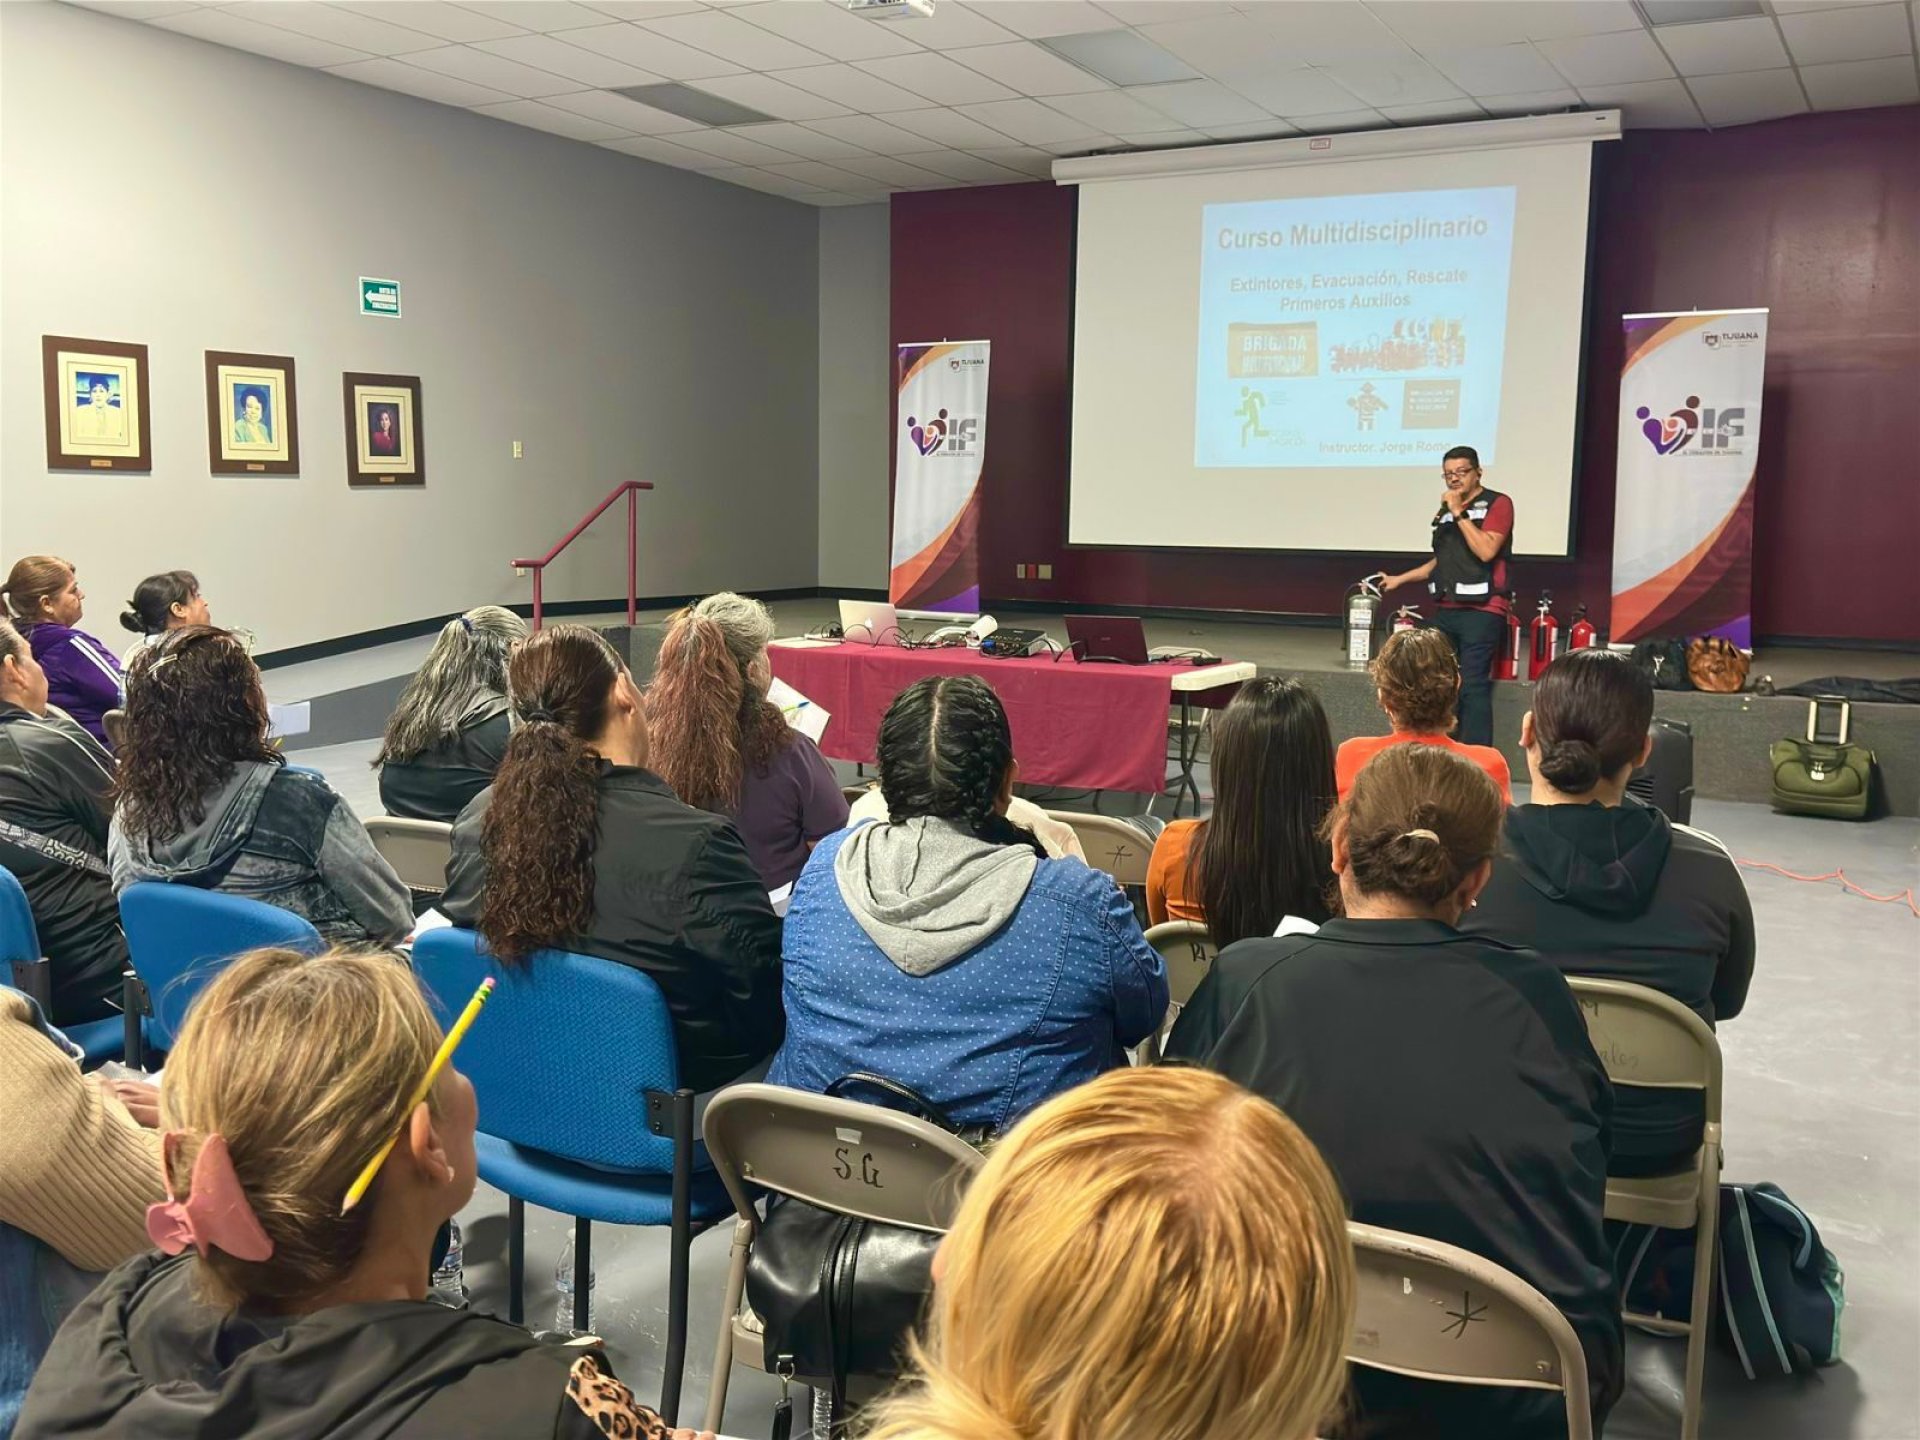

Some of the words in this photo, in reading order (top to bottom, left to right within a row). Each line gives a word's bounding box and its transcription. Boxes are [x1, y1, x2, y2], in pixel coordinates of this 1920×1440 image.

[1218, 228, 1283, 250] Curso
[1291, 216, 1488, 247] Multidisciplinario
[1230, 277, 1306, 293] Extintores,
[1311, 271, 1401, 290] Evacuación,
[1406, 269, 1468, 284] Rescate
[1280, 296, 1346, 312] Primeros
[1351, 292, 1411, 308] Auxilios
[1380, 441, 1414, 455] Jorge
